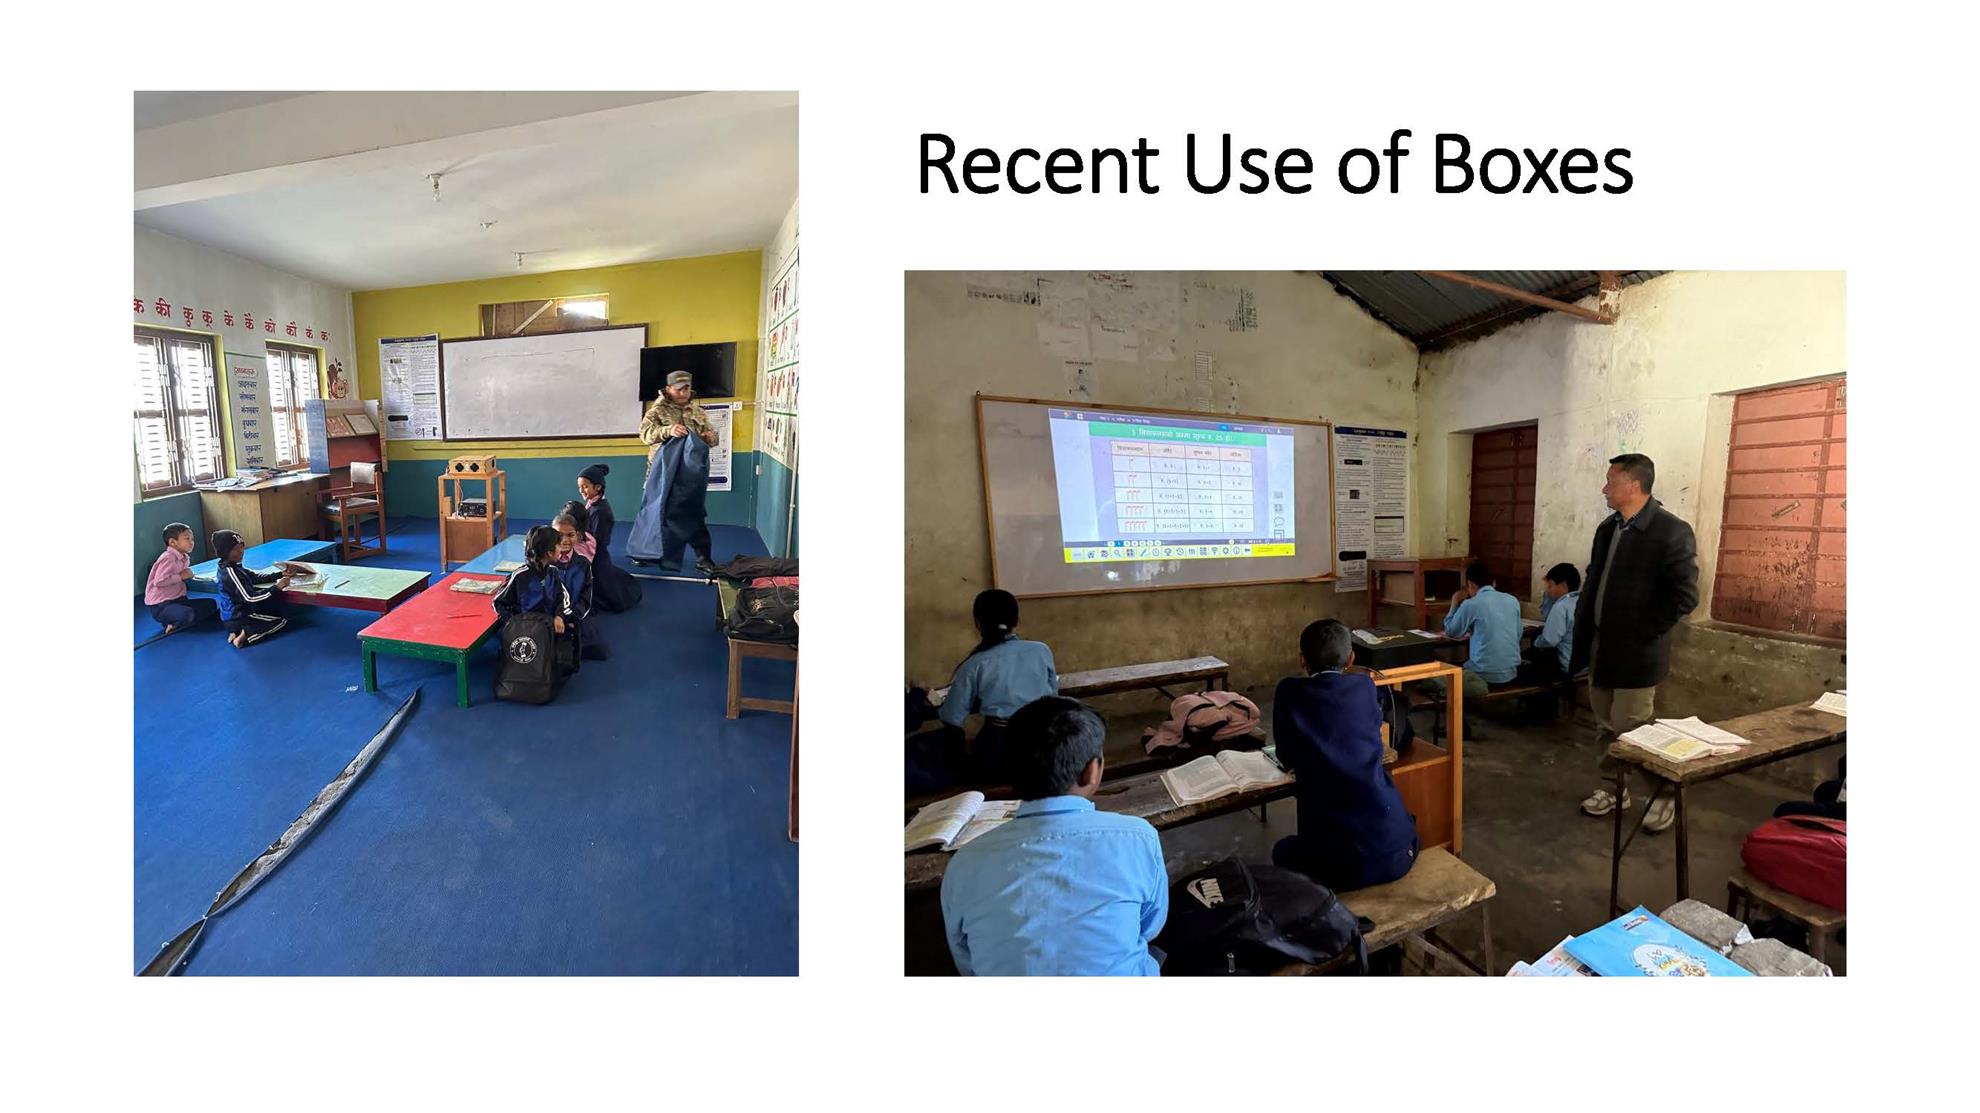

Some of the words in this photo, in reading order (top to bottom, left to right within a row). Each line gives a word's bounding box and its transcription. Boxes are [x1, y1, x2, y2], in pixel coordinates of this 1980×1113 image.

[155, 298, 171, 318] की
[183, 307, 194, 327] कु
[224, 310, 234, 326] के
[244, 313, 254, 330] कै
[264, 318, 276, 335] को
